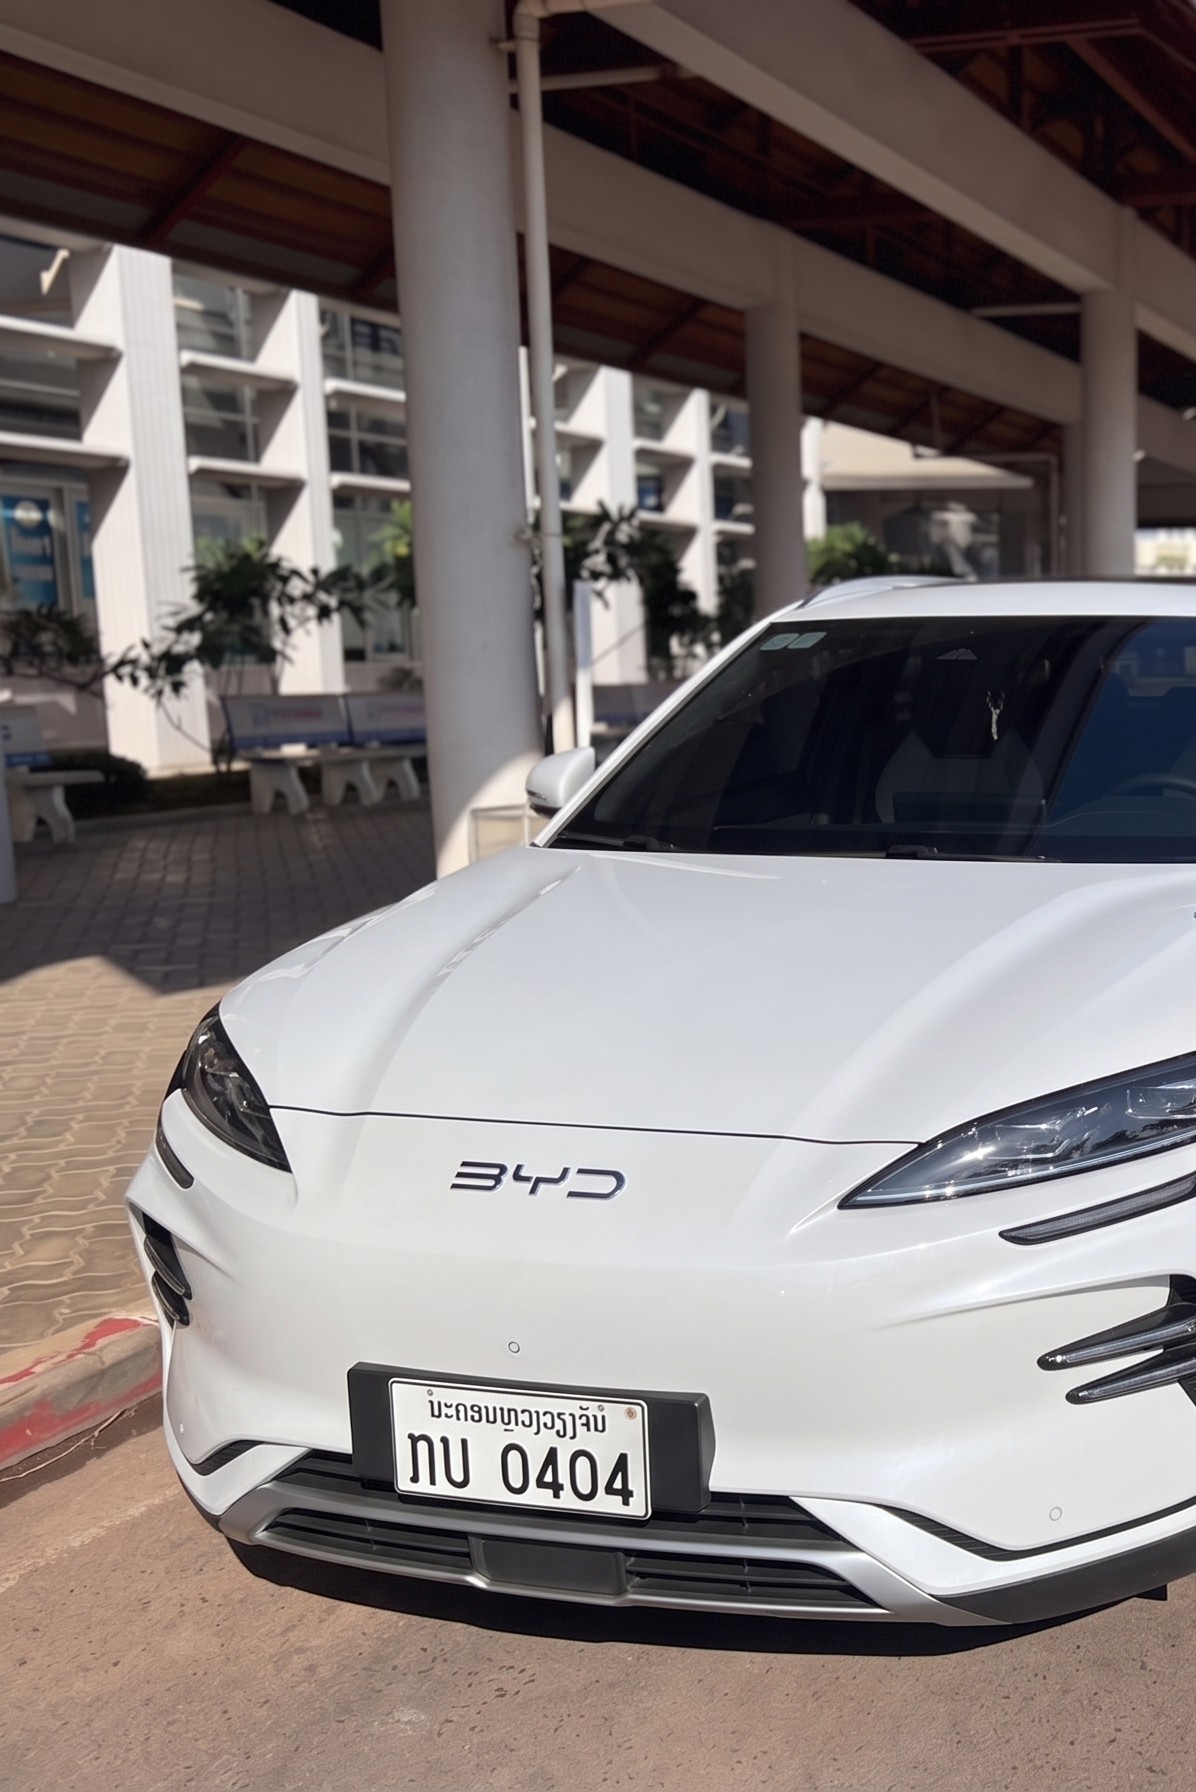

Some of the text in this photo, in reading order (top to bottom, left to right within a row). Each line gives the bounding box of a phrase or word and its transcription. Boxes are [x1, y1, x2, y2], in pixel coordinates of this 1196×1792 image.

[450, 1160, 626, 1200] BYD
[407, 1432, 634, 1506] ກບ 0404
